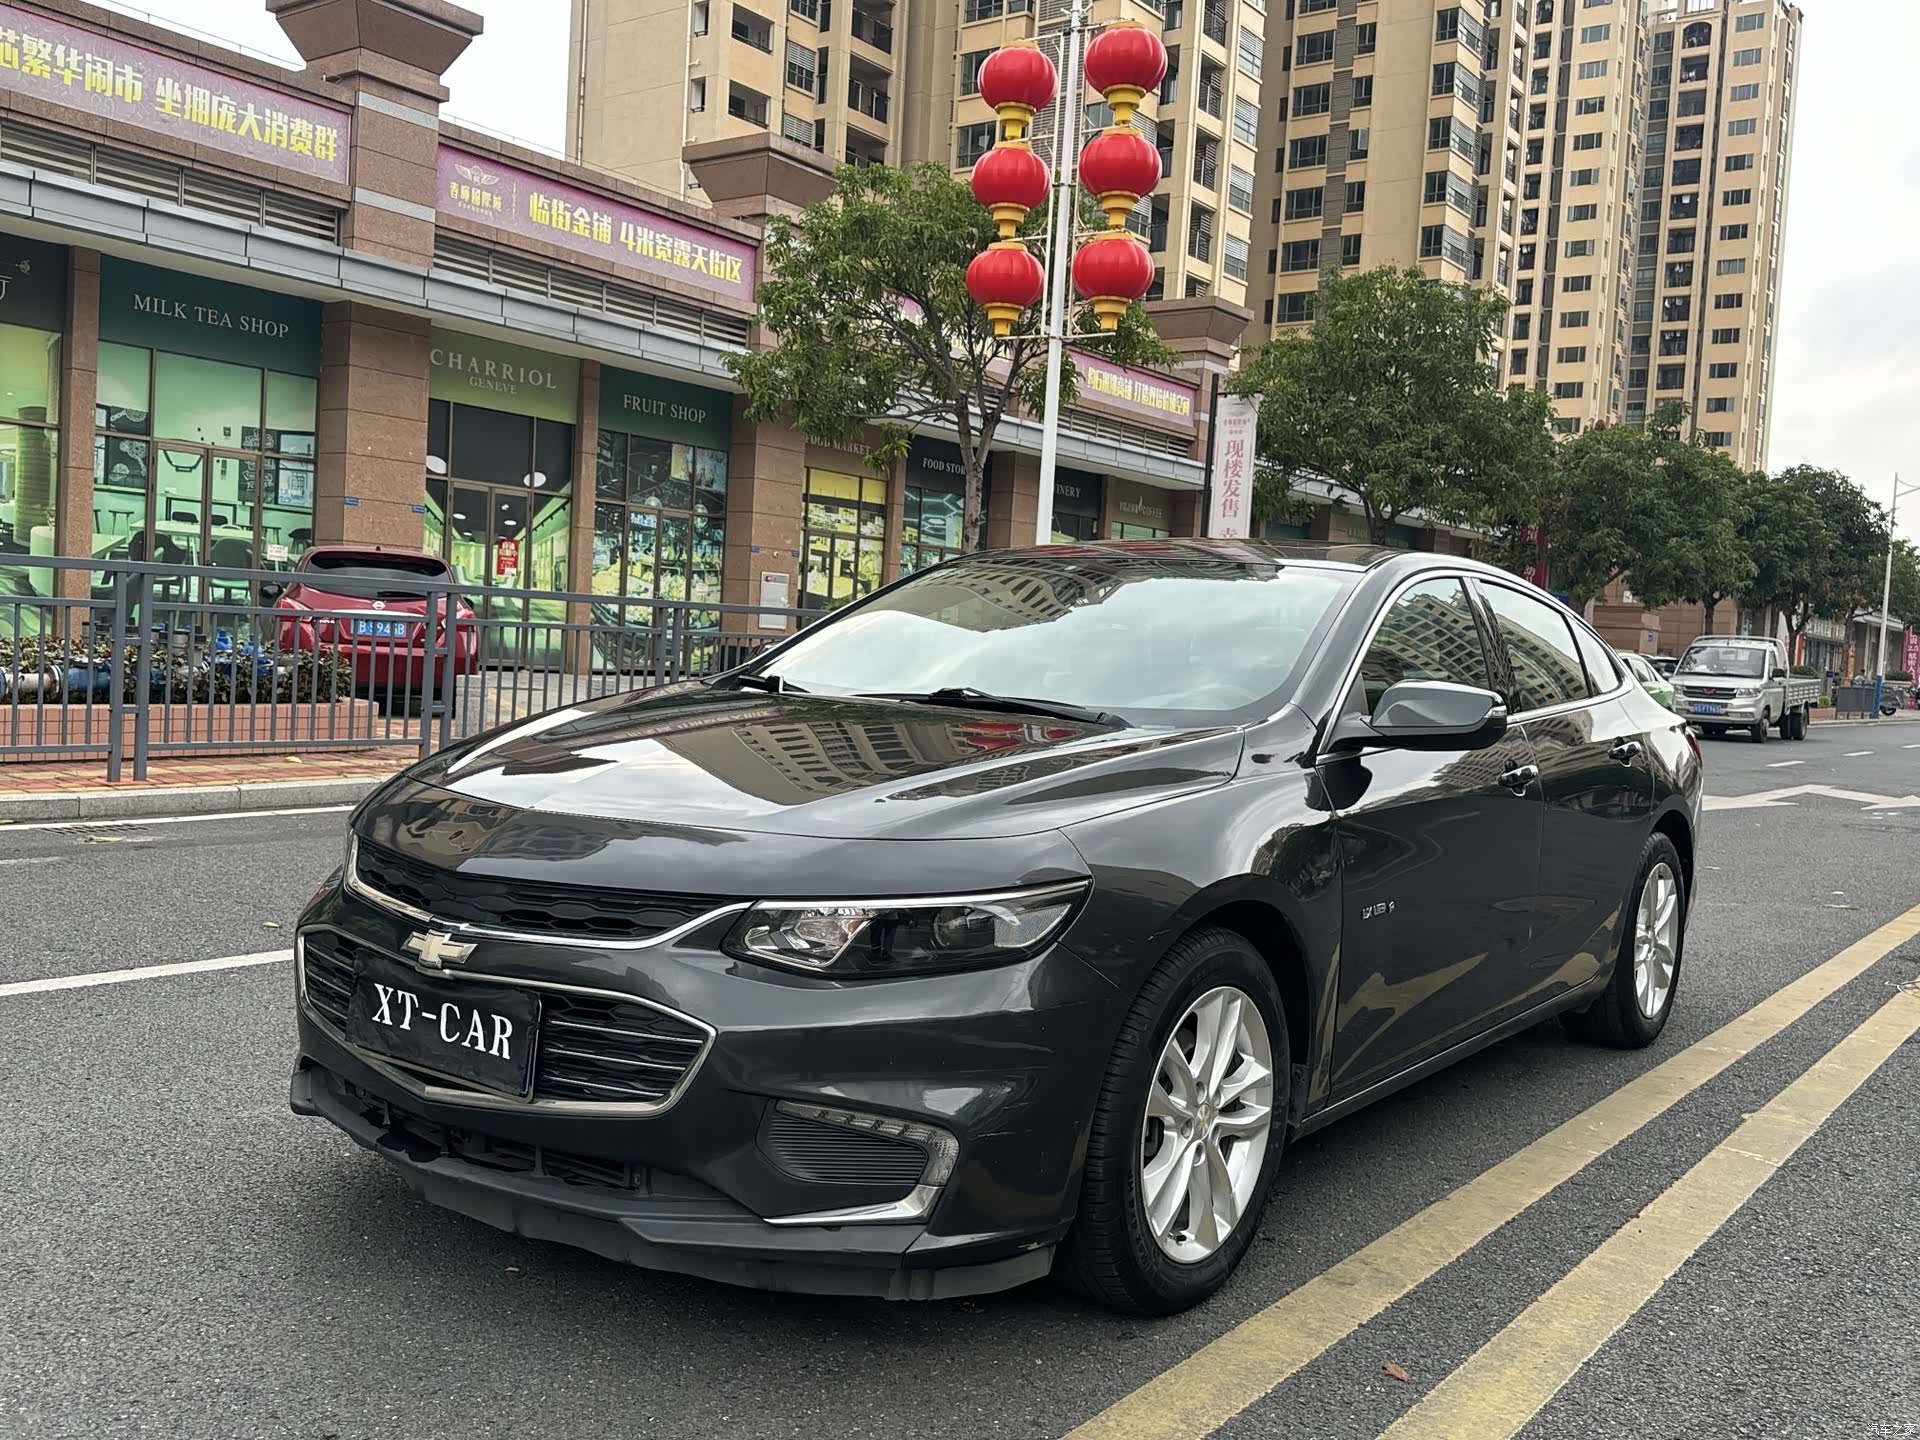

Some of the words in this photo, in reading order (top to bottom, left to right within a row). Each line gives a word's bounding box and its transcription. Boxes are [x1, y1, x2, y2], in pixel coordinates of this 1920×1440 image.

[155, 76, 338, 162] 坐拥庞大消费群
[528, 191, 613, 245] 临街金铺
[619, 221, 744, 285] 4米宽露天街区
[134, 293, 187, 320] MILK
[194, 306, 233, 329] TEA
[239, 315, 289, 338] SHOP
[429, 348, 557, 389] CHARRIOL
[469, 376, 518, 395] GENEVE
[623, 394, 667, 416] FRUIT
[670, 404, 706, 424] SHOP
[922, 457, 945, 471] FOOD
[945, 462, 967, 476] STOR
[1222, 439, 1245, 519] 现楼发售
[1055, 483, 1081, 499] INERY
[371, 982, 513, 1060] XT-CAR
